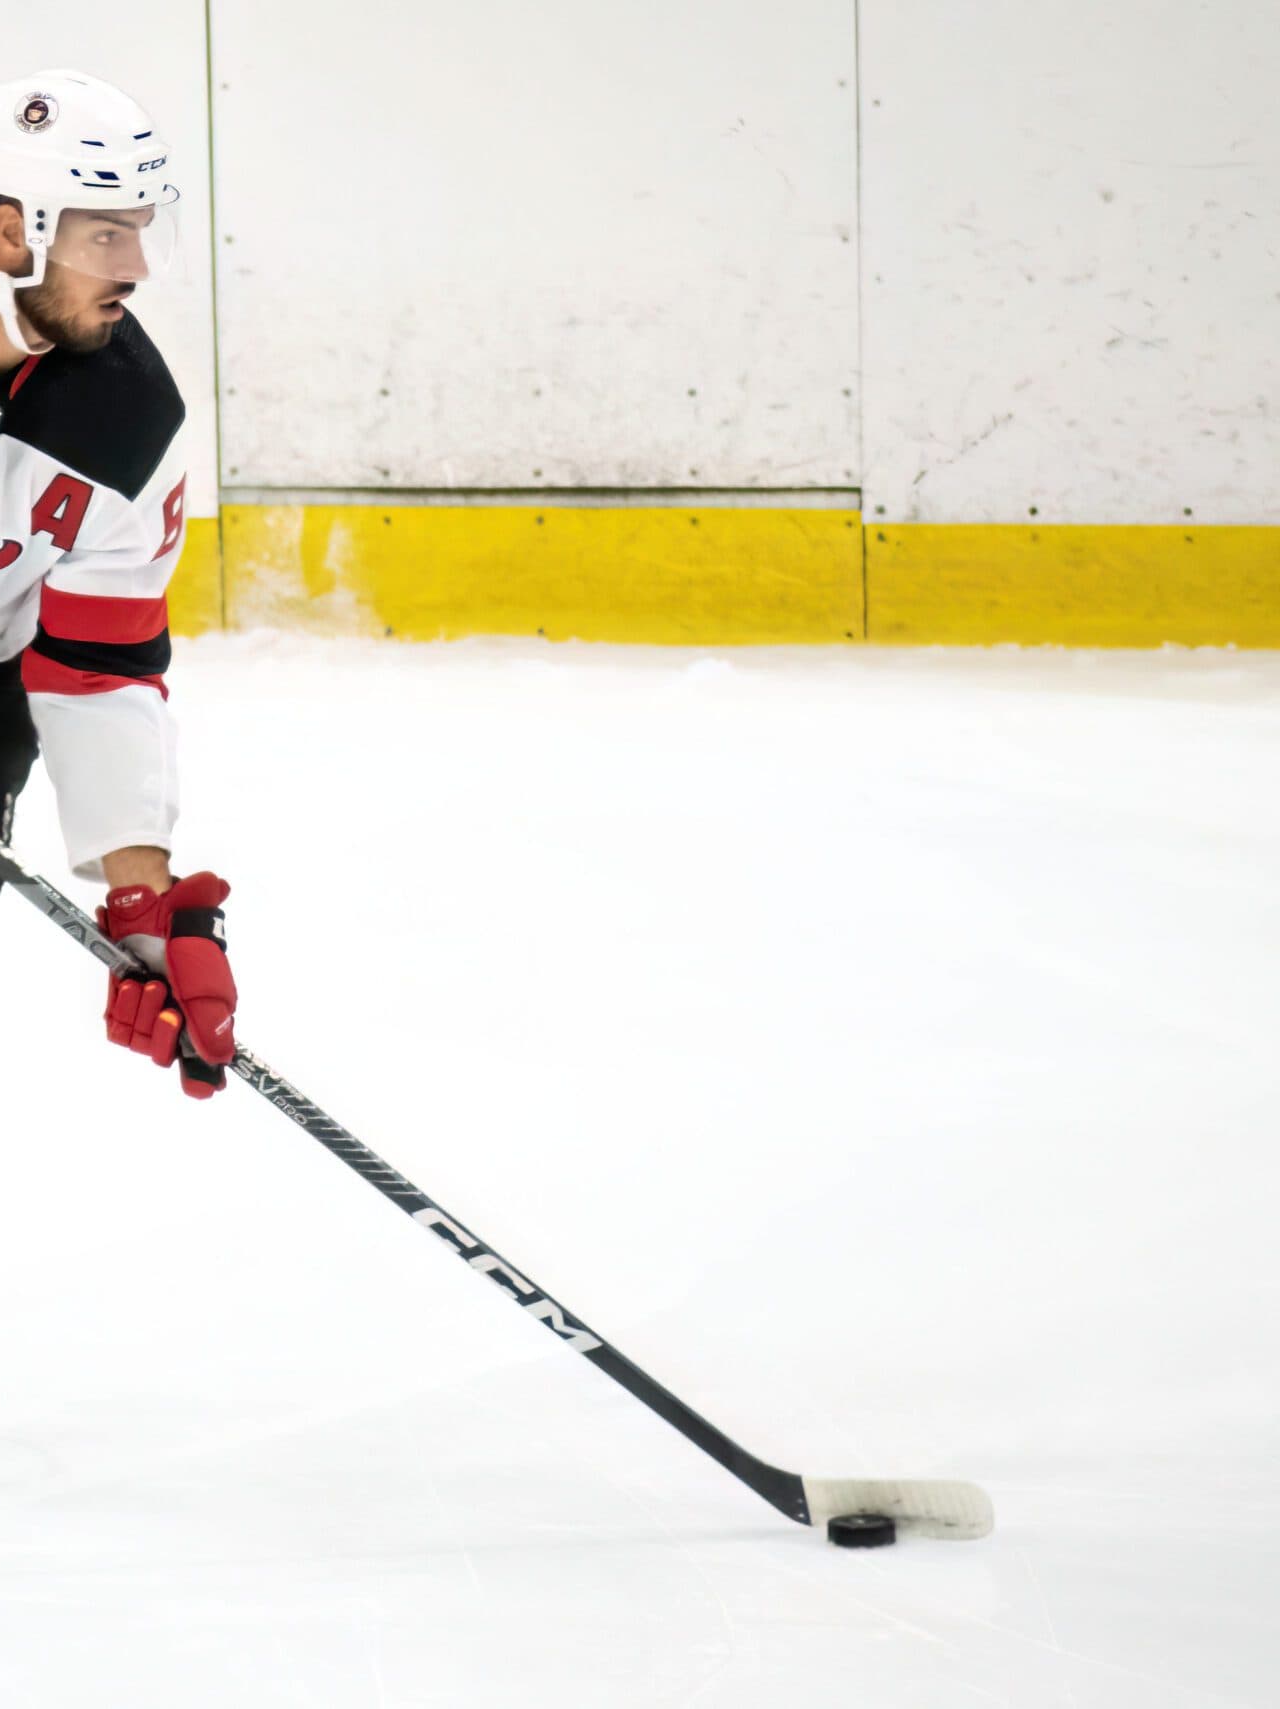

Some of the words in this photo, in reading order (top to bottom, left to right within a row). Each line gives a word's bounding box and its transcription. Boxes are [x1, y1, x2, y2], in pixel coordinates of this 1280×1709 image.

[31, 473, 94, 552] A
[46, 896, 117, 967] TAC
[233, 1058, 280, 1095] S-V
[411, 1207, 604, 1353] CCM
